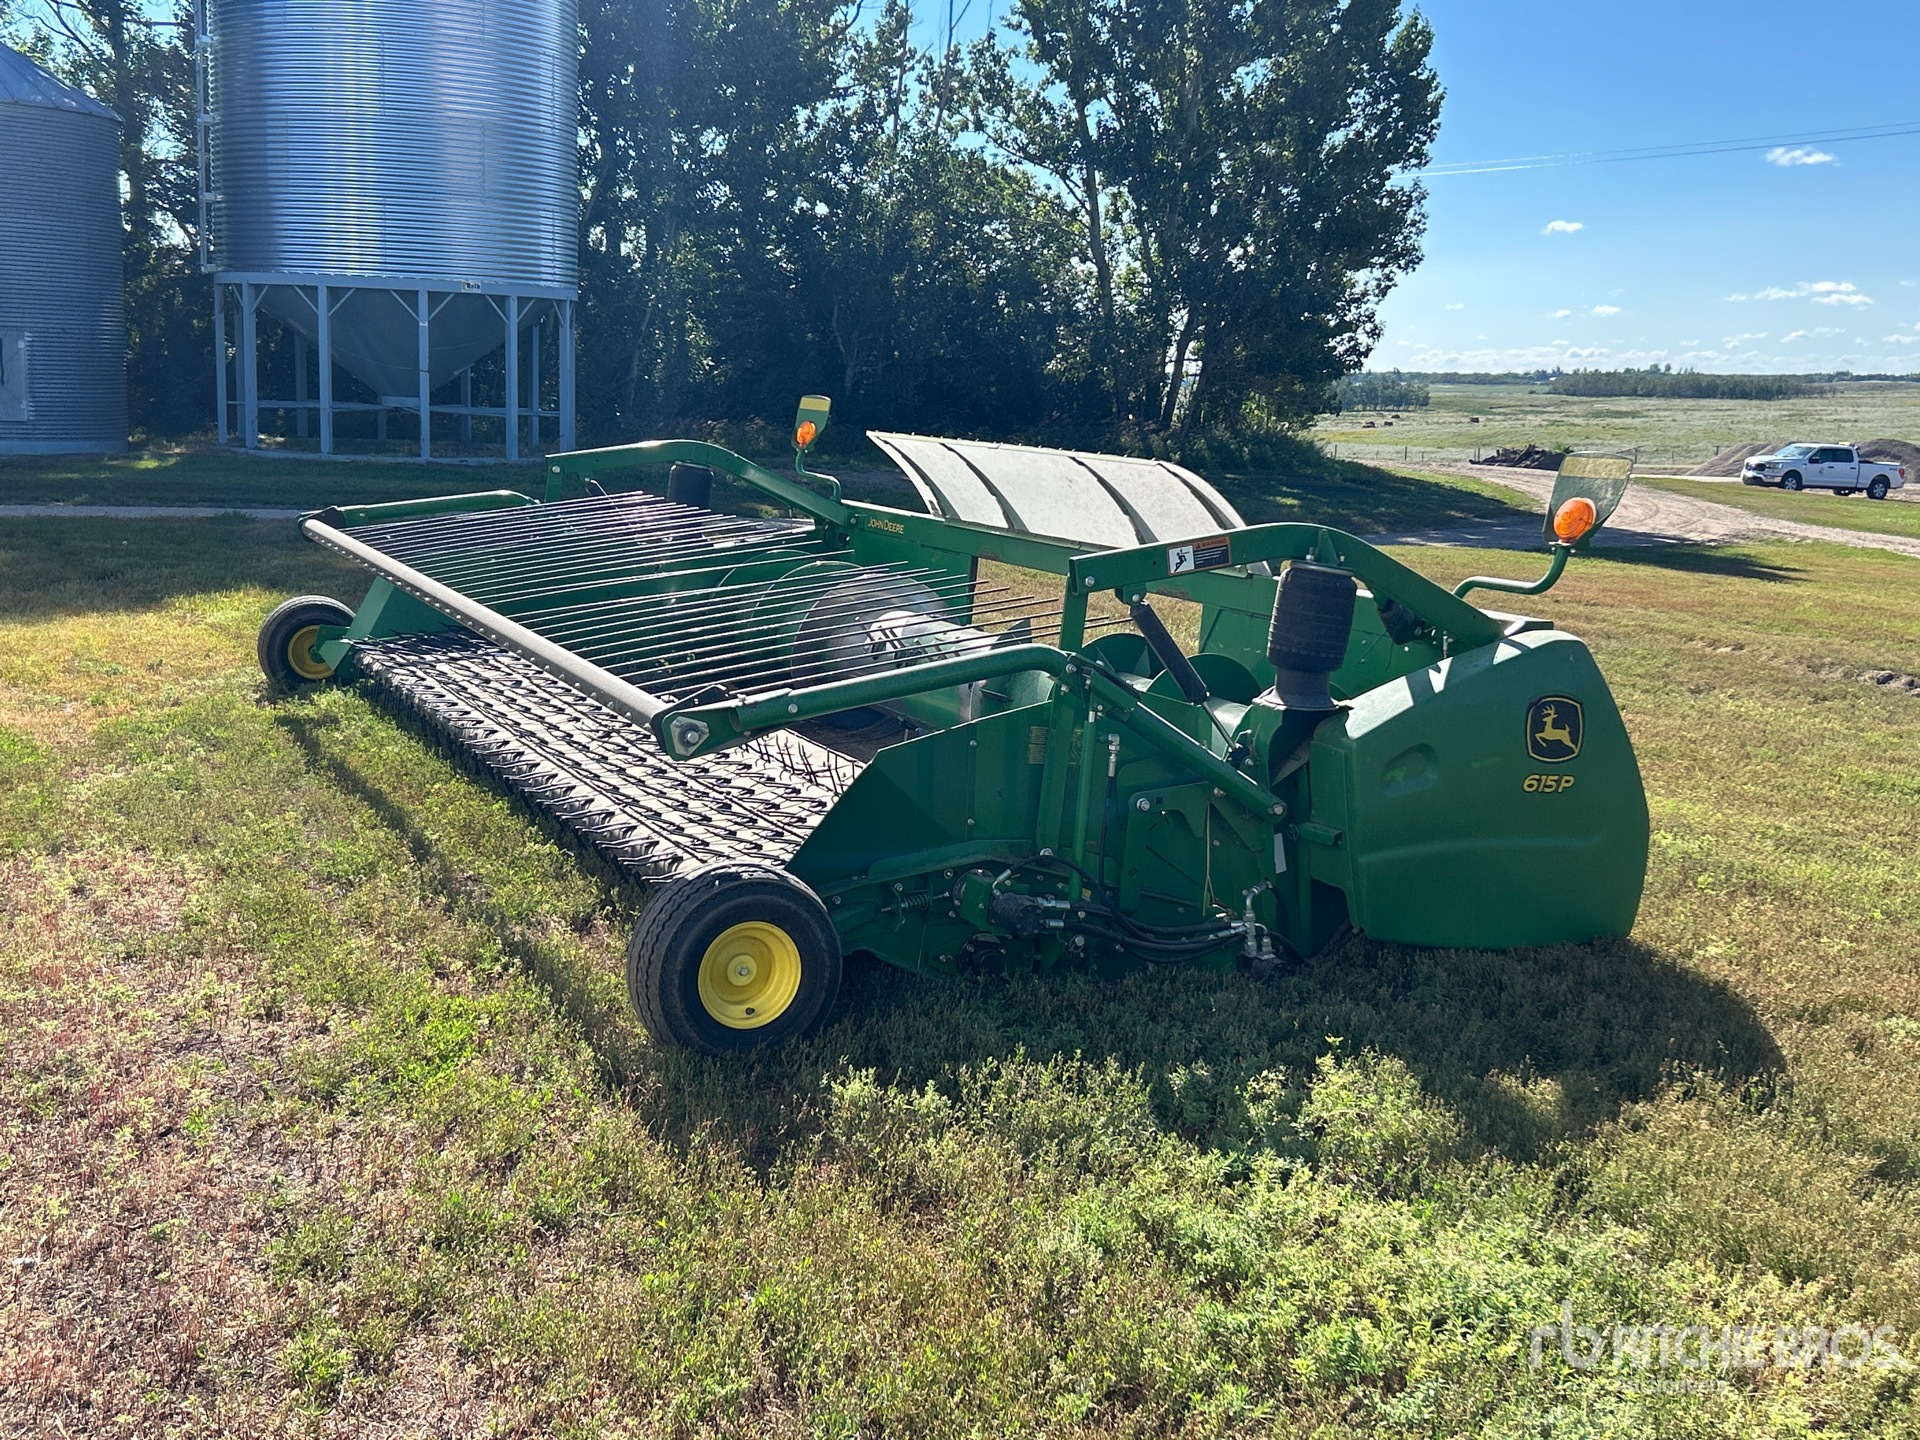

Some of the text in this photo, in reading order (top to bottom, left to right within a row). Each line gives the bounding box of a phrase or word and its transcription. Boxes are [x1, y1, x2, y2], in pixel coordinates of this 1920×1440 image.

[868, 516, 905, 534] JOHN DEERE
[1522, 774, 1575, 793] 615P
